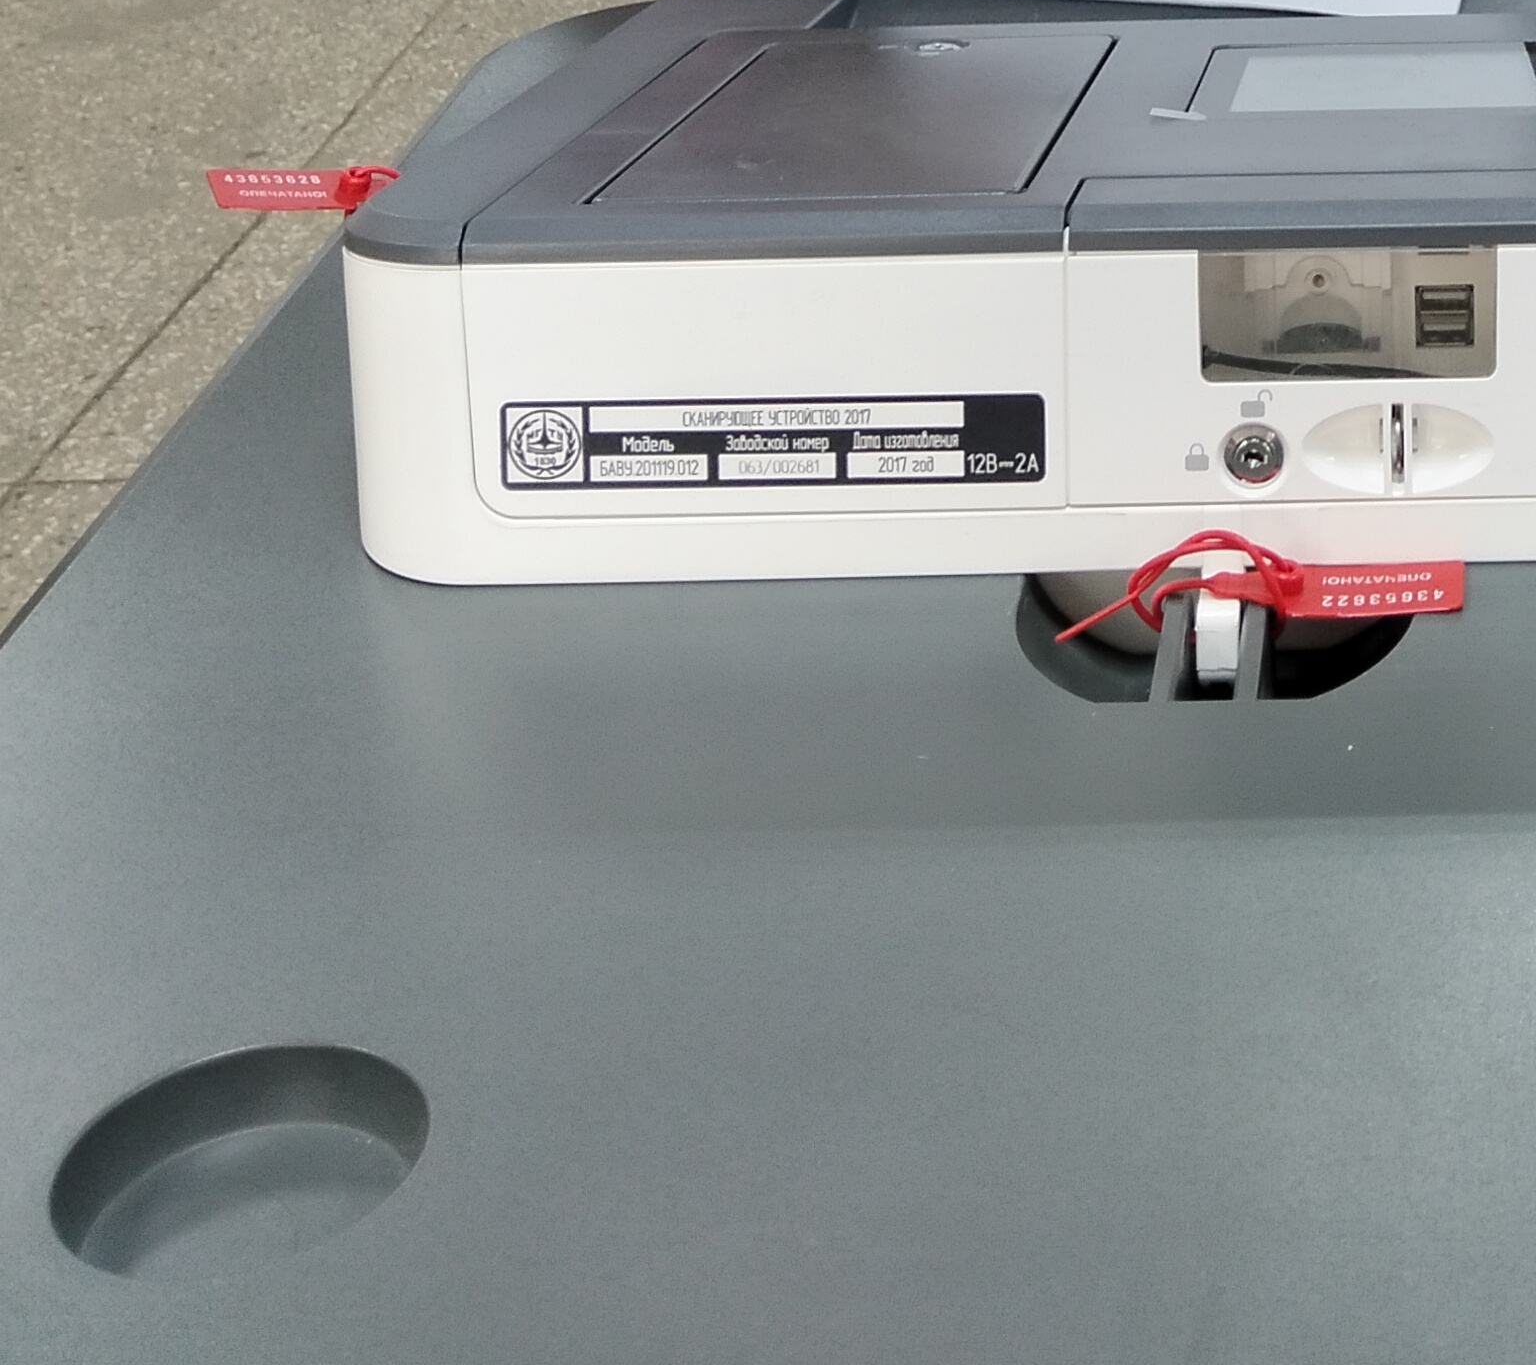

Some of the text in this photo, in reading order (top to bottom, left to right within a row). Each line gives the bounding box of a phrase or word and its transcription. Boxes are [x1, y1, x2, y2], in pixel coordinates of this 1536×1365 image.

[239, 189, 328, 199] ОПЕЧАТАНО!
[682, 407, 871, 427] СКАНИРУЮЩЕЕ УСТРОЙСТВО 2017
[621, 435, 675, 453] Модель
[725, 433, 830, 453] Заводской номер
[852, 430, 959, 450] Дата изготовления
[599, 459, 699, 477] БАВУ.201119.012
[738, 458, 820, 475] 063/002681
[878, 456, 935, 473] 2017 год
[1322, 572, 1433, 586] ОПЕЧАТАНО!
[1321, 588, 1444, 608] 43653622
